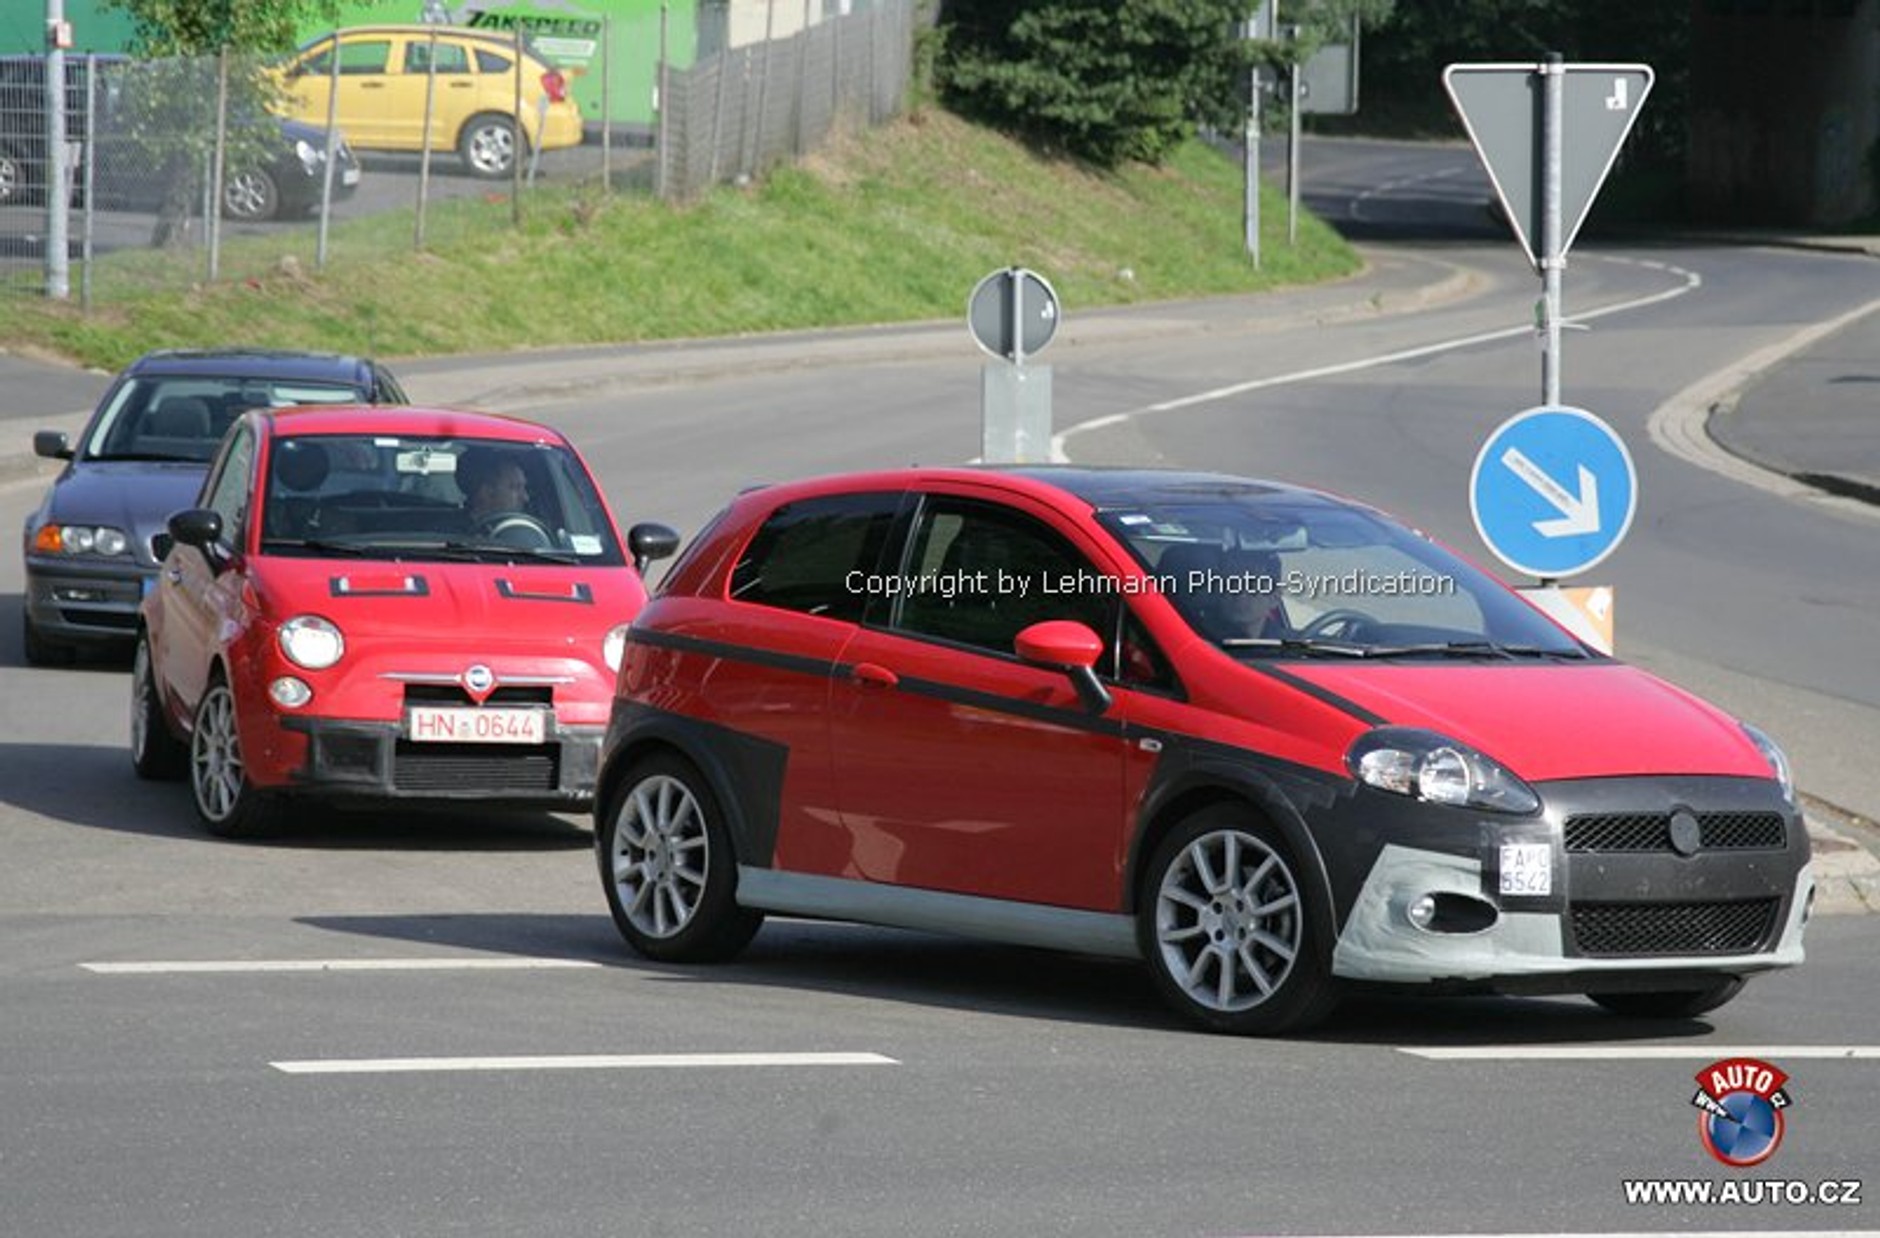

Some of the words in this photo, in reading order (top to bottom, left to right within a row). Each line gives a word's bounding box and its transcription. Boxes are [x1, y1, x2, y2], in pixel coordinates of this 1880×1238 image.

[467, 10, 601, 34] ZAKSPEED
[418, 714, 455, 737] HN
[475, 714, 533, 737] 0644
